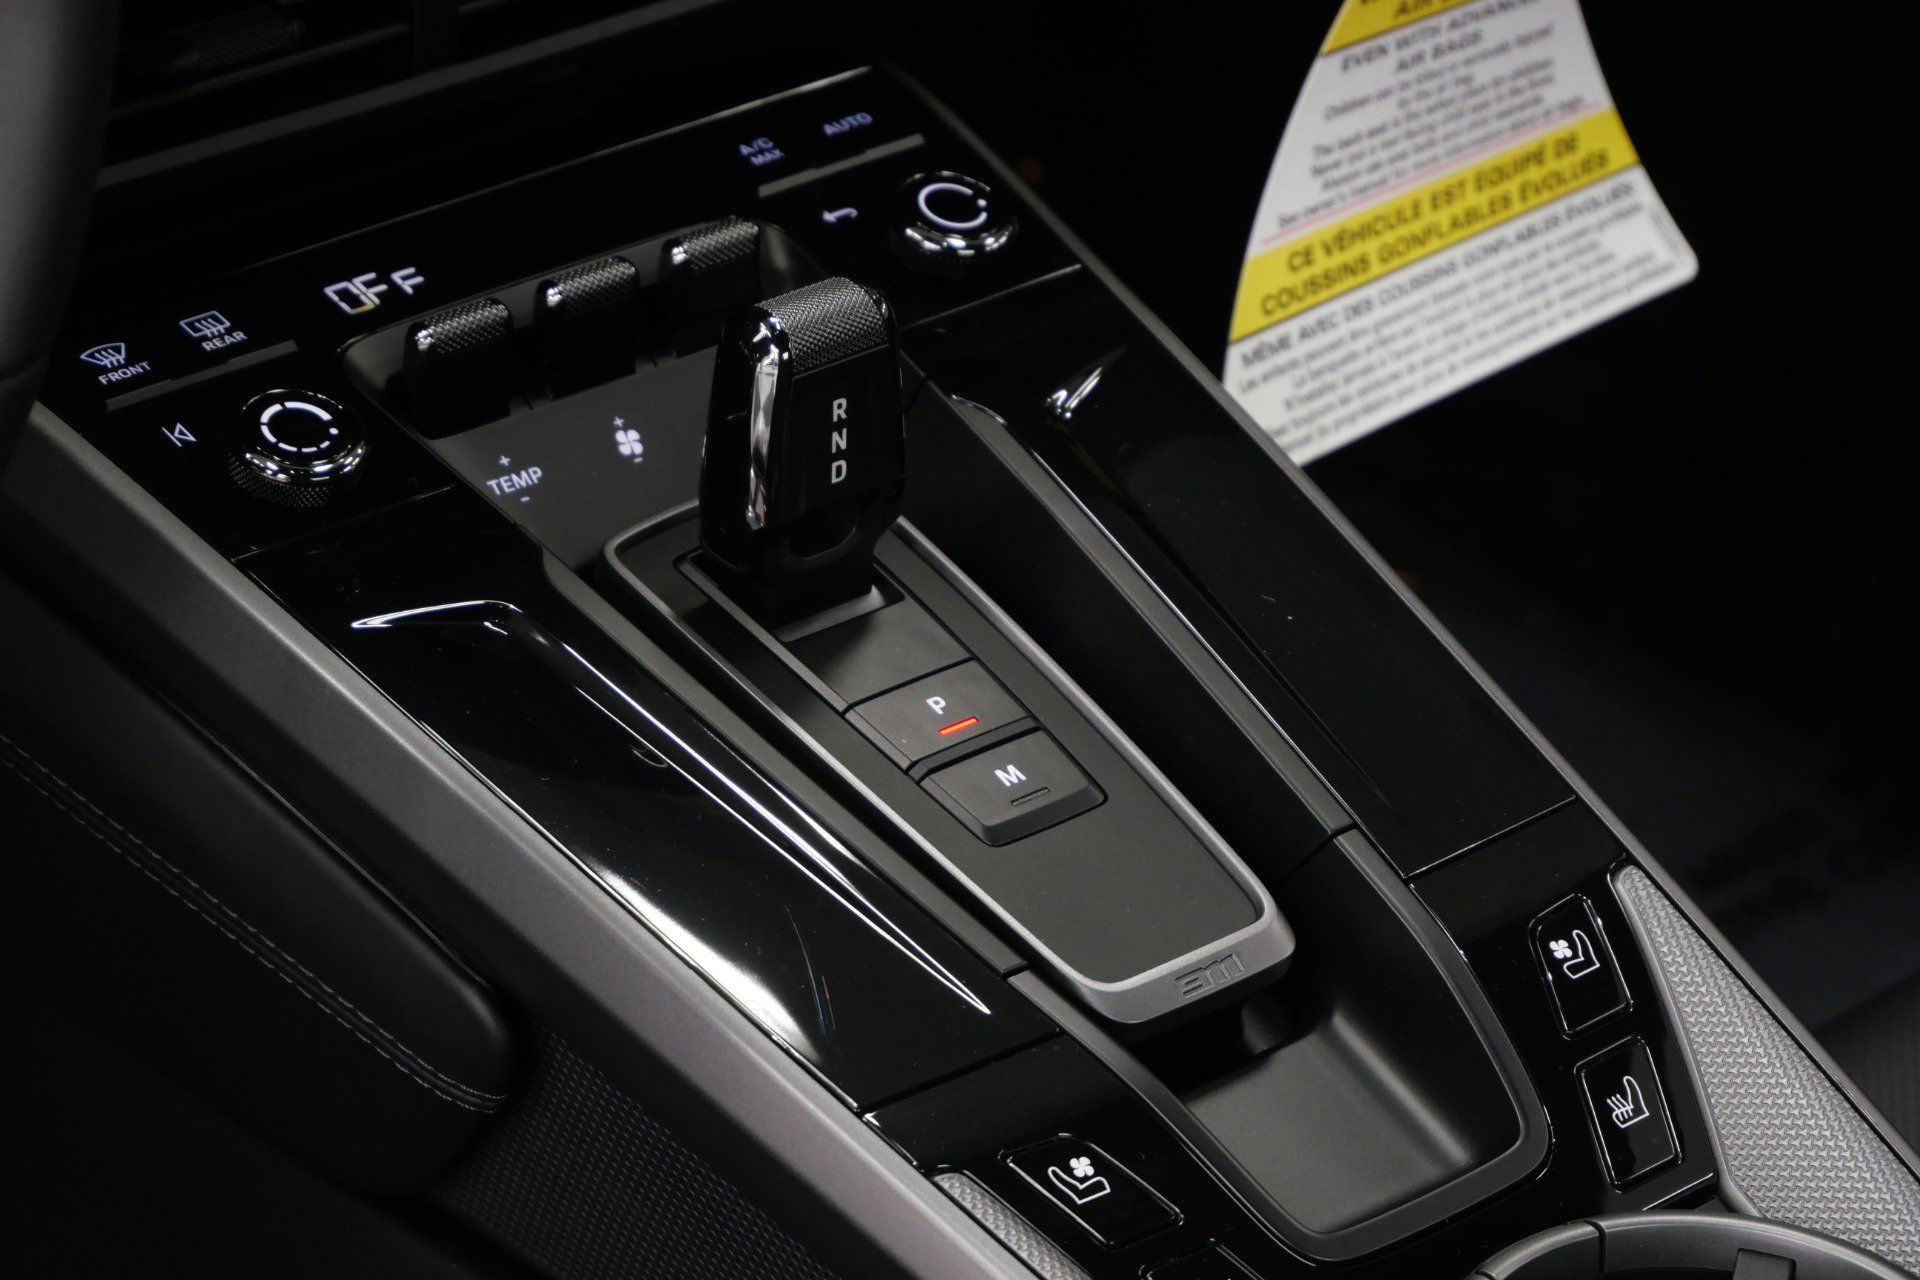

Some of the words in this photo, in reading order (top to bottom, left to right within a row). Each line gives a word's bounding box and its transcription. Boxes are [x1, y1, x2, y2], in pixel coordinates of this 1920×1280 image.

[1342, 41, 1386, 73] EVEN
[1396, 49, 1426, 74] AIR
[1431, 26, 1482, 61] BAGS
[823, 112, 873, 136] AUTO
[738, 137, 774, 157] A/C
[750, 148, 785, 166] MAX
[1289, 244, 1313, 274] CE
[1323, 194, 1421, 259] VÉHICULE
[1430, 177, 1468, 212] EST
[1553, 130, 1579, 161] DE
[1261, 248, 1371, 317] COUSSINS
[1378, 187, 1513, 266] GONFLABLES
[1297, 309, 1338, 343] AVEC
[201, 330, 247, 352] REAR
[98, 361, 151, 386] FRONT
[833, 397, 847, 423] R
[831, 428, 847, 454] N
[487, 466, 543, 496] TEMP
[831, 459, 847, 484] D
[926, 696, 946, 715] P
[994, 764, 1027, 787] M
